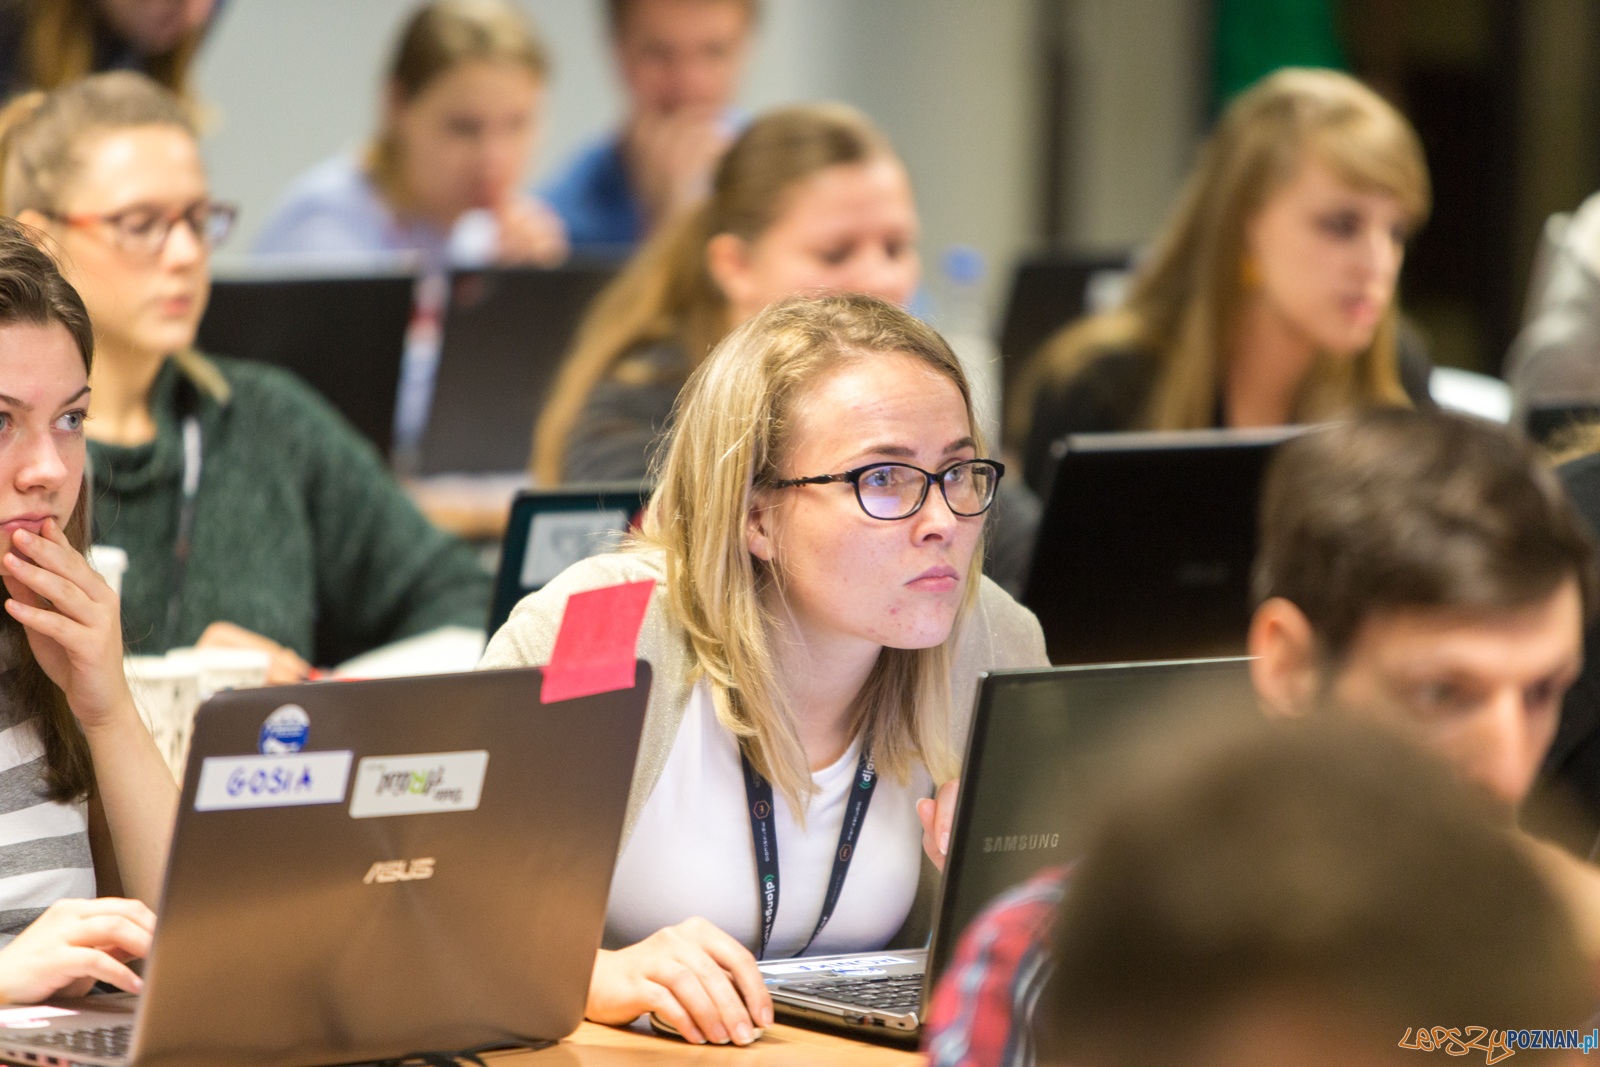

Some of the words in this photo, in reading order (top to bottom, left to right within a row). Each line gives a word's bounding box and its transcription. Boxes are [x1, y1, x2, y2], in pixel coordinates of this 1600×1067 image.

[226, 765, 313, 796] GOSIA
[983, 833, 1060, 853] SAMSUNG
[363, 857, 436, 884] ASUS
[764, 881, 775, 923] django
